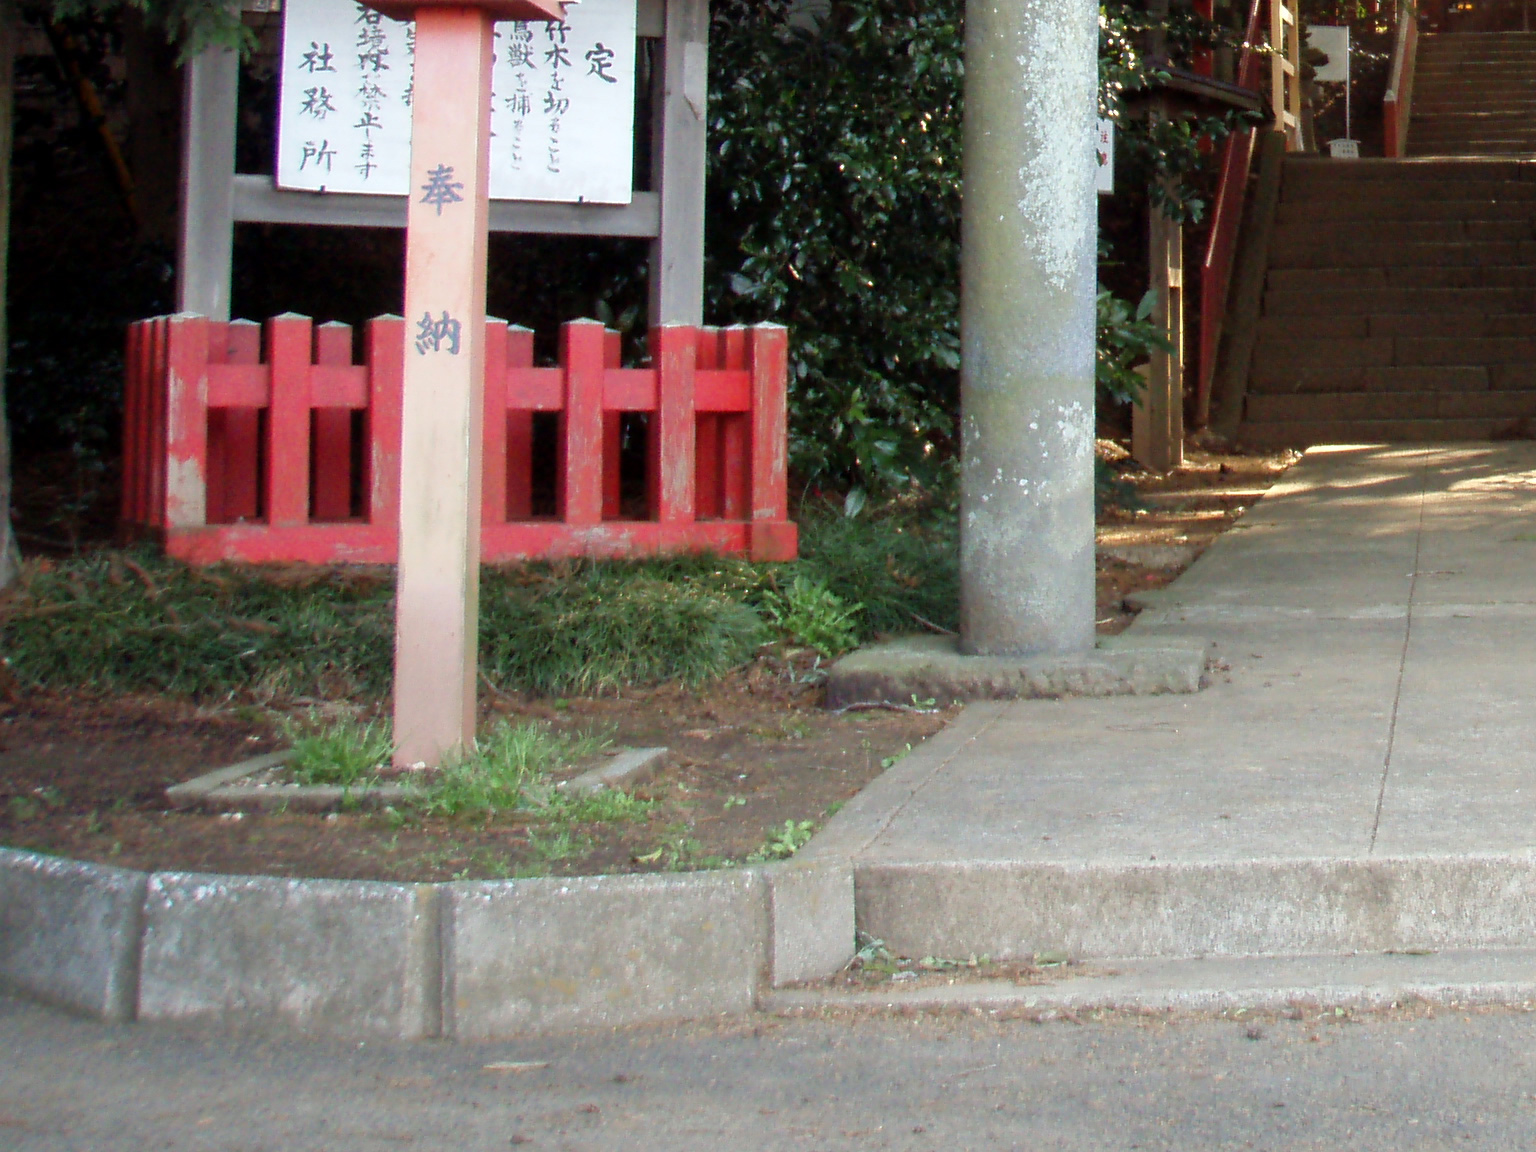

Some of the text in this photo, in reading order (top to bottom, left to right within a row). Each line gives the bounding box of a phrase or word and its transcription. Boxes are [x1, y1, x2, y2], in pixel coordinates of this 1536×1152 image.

[298, 40, 338, 173] 社務所
[584, 41, 618, 84] 定
[415, 163, 464, 356] 奉納
